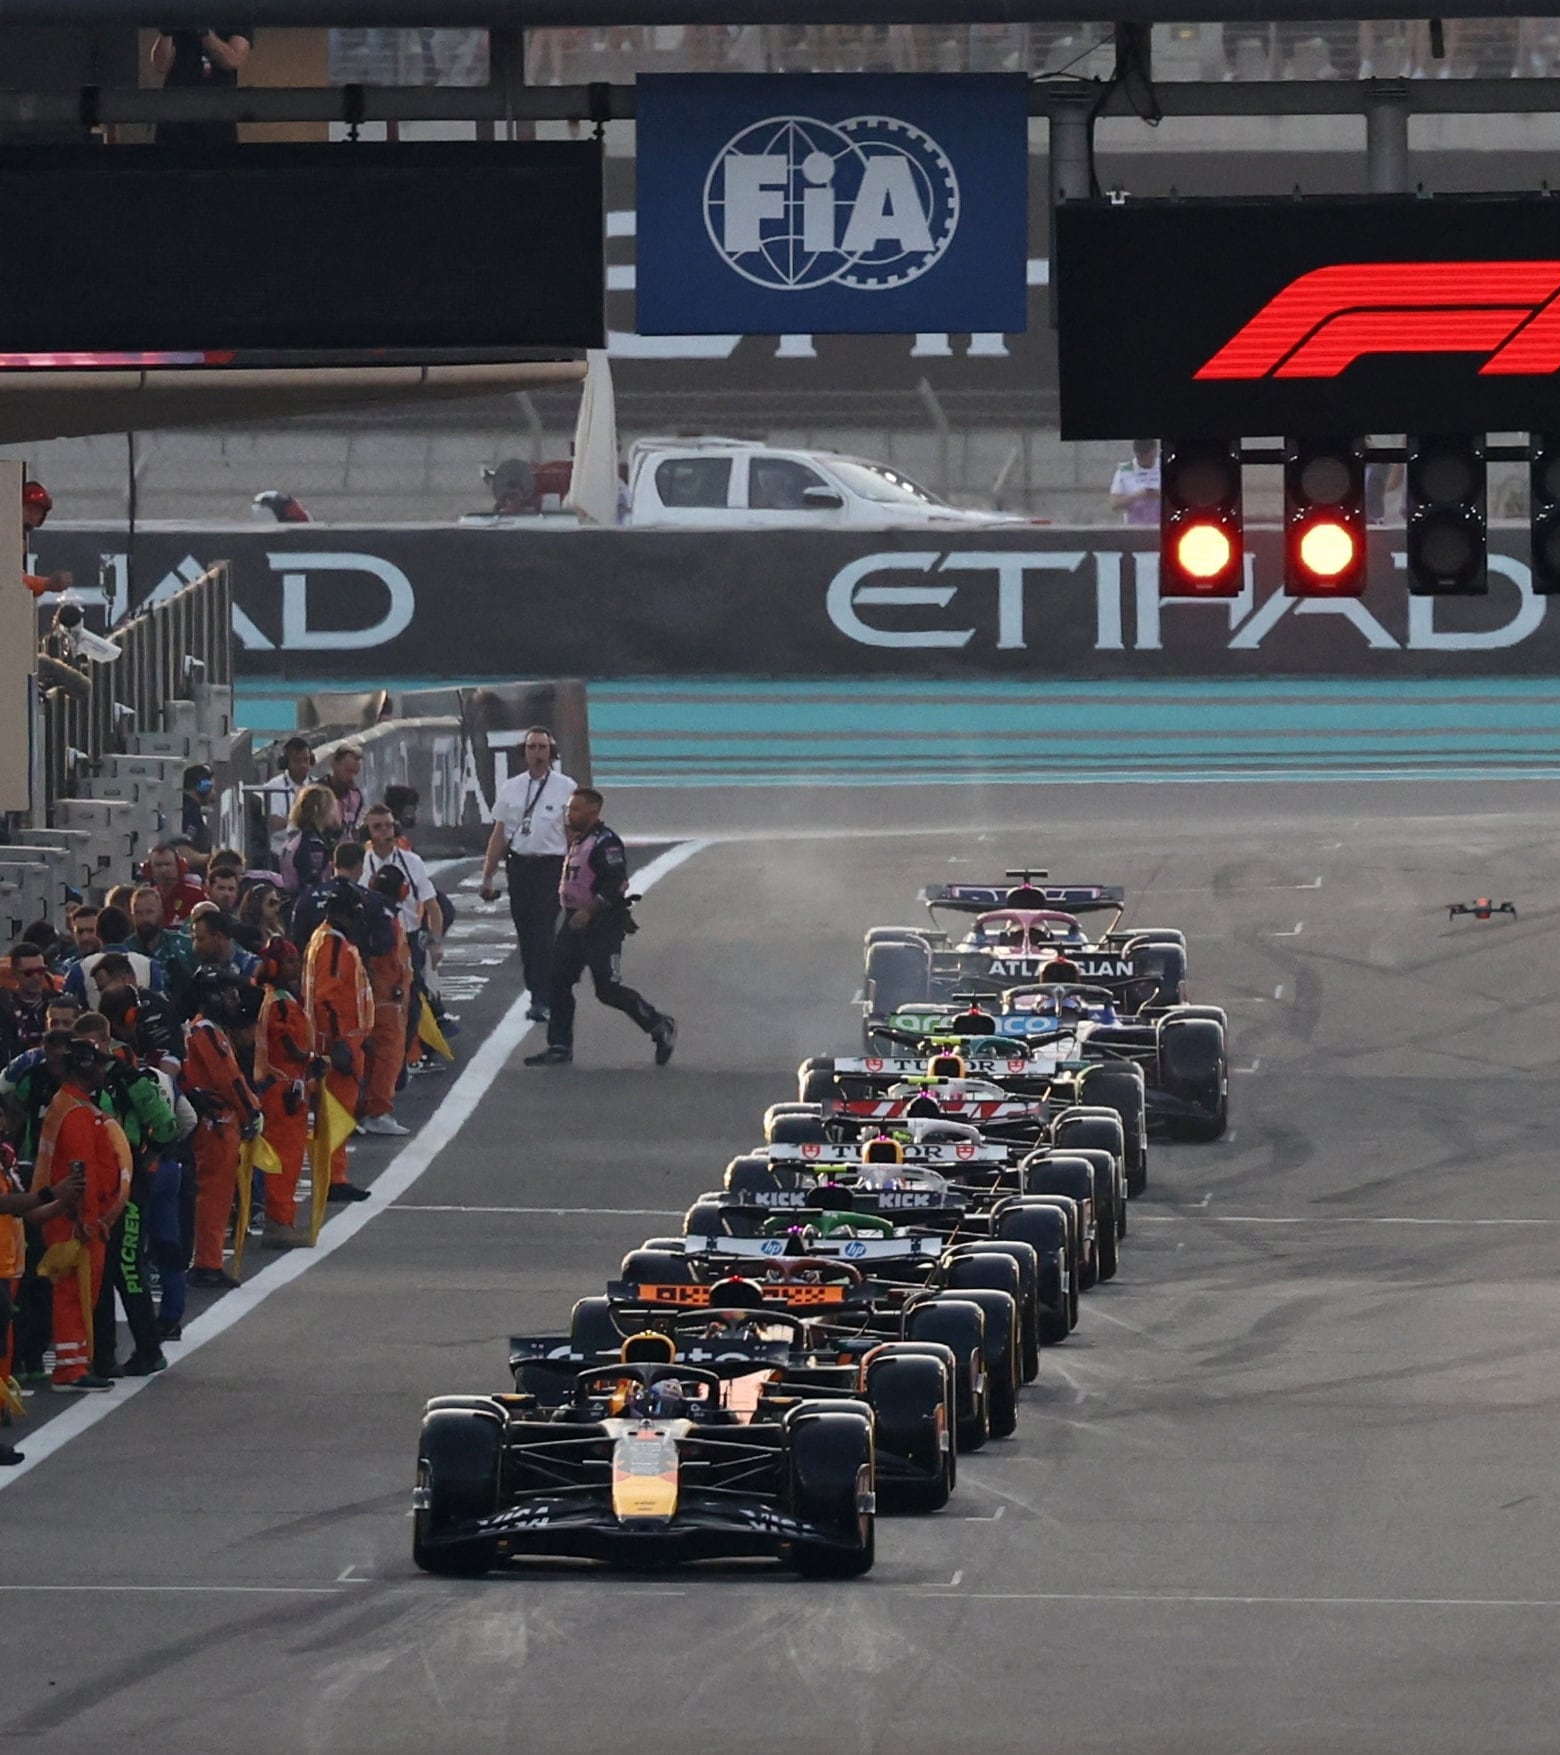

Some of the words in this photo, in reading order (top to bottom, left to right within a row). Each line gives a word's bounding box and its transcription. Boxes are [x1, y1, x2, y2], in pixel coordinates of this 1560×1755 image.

[826, 550, 1548, 649] ETIHAD
[988, 960, 1134, 977] ATLSIAN
[895, 1015, 1052, 1034] arco
[893, 1060, 996, 1072] TUOR
[831, 1146, 944, 1159] TOR
[755, 1192, 806, 1207] KICK
[878, 1193, 930, 1208] KICK
[761, 1239, 783, 1256] hp
[844, 1241, 867, 1258] hp
